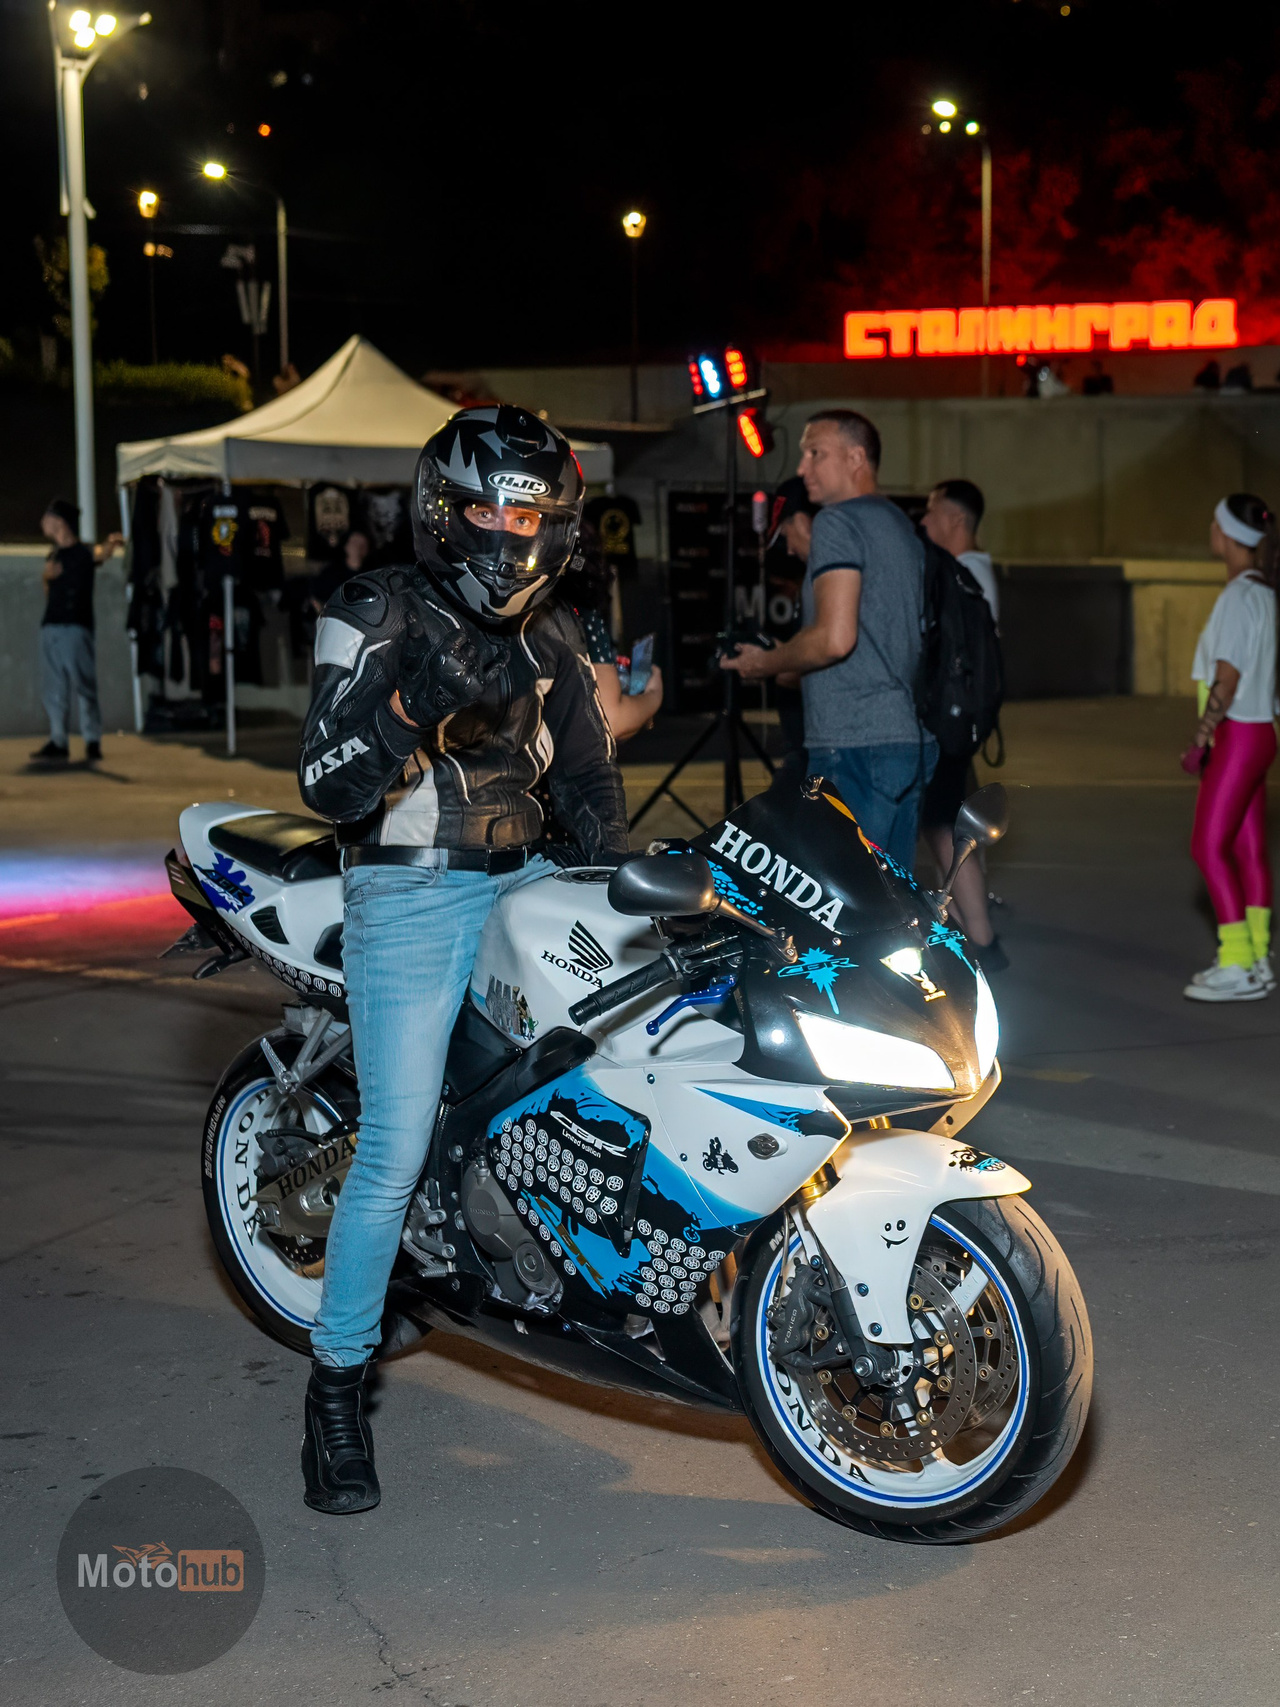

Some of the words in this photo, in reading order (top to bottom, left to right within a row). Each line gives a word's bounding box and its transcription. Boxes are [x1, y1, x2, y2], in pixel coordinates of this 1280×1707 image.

[844, 298, 1239, 359] СТАЛИНГРАД
[496, 475, 543, 492] HJC
[709, 820, 845, 932] HONDA
[540, 949, 604, 989] HONDA
[777, 957, 860, 978] CBR
[549, 1110, 628, 1158] CBR
[275, 1137, 357, 1200] HONDA
[784, 1308, 798, 1345] TOKICO
[774, 1361, 876, 1488] ONDA
